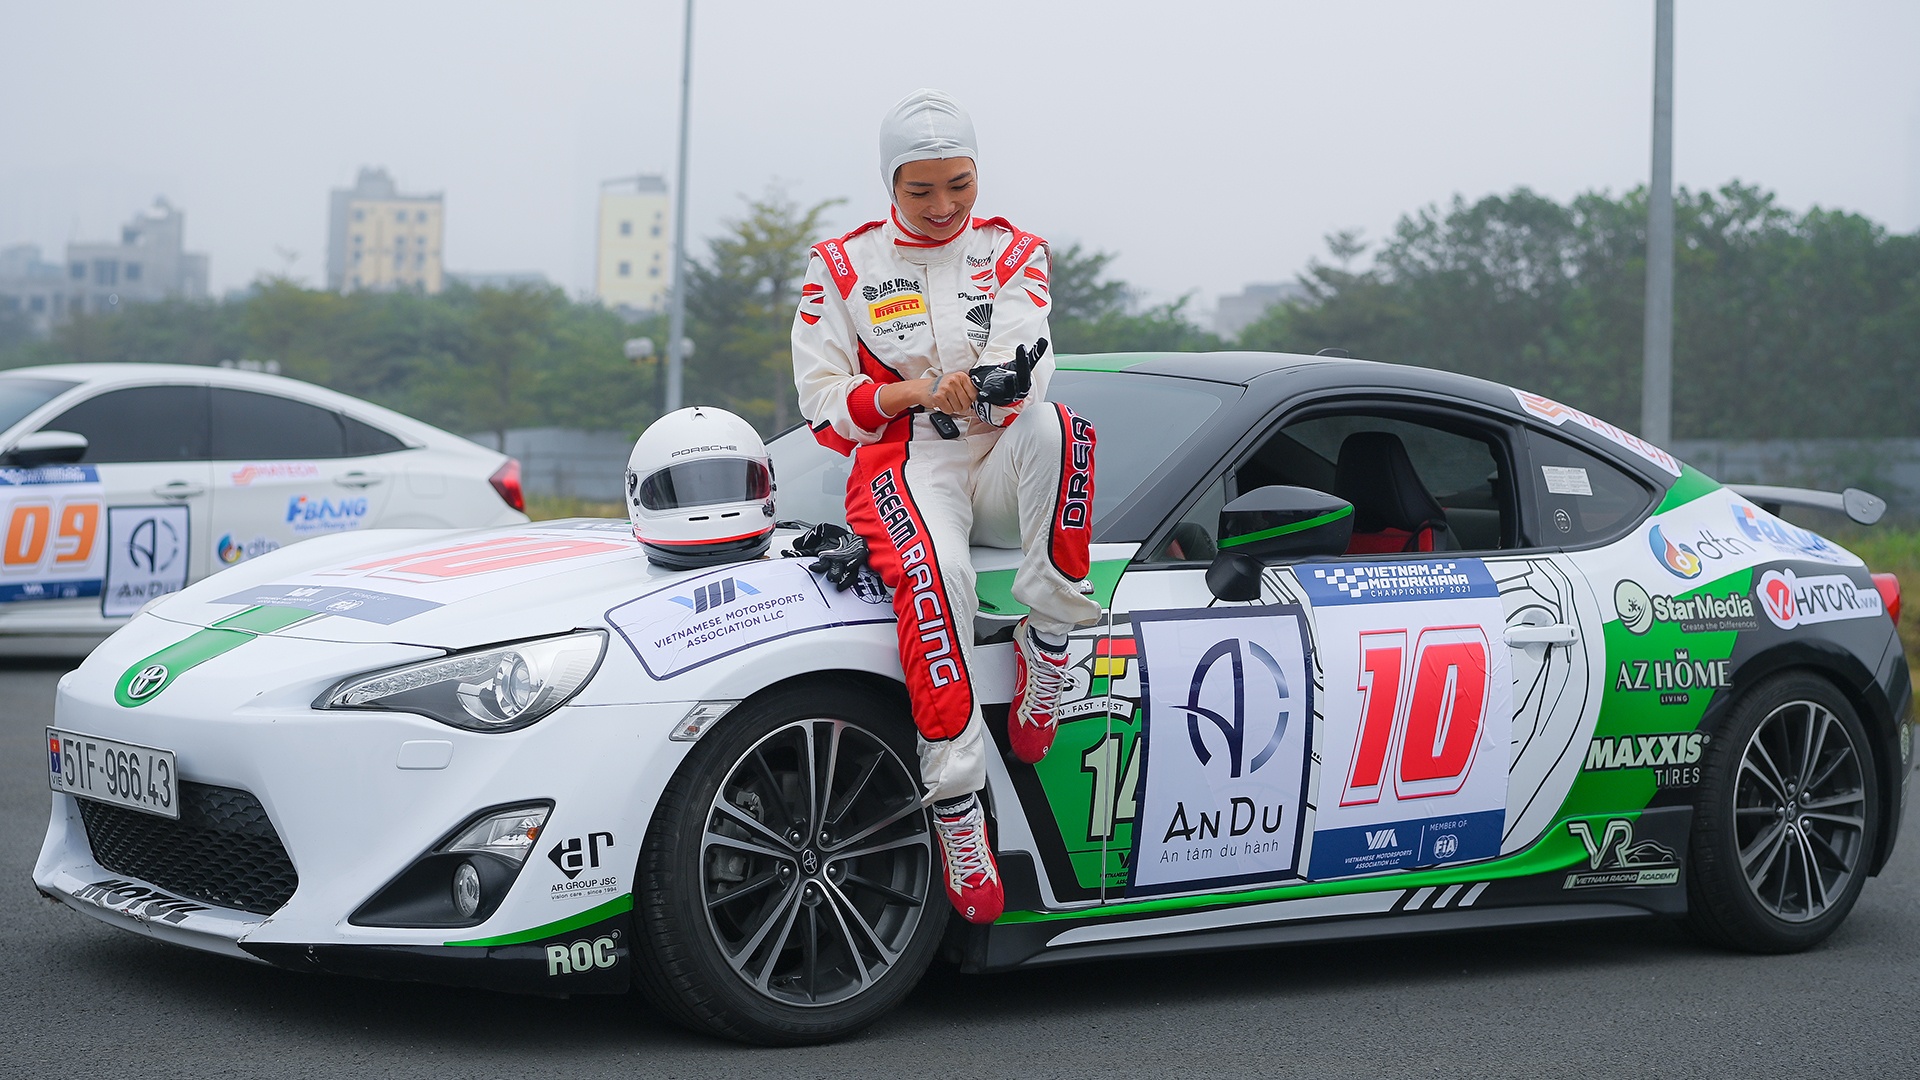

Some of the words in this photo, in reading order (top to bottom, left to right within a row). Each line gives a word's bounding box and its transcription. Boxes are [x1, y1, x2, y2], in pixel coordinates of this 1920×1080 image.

[827, 242, 849, 276] sparco
[1004, 236, 1030, 267] sparco
[878, 280, 893, 295] LAS
[894, 278, 920, 291] VEGAS
[873, 298, 920, 319] PIRELLI
[872, 325, 894, 337] Dom
[671, 444, 738, 458] PORSCHE
[1062, 404, 1093, 530] DREA
[870, 467, 918, 550] DREAM
[2, 501, 100, 569] 09
[1696, 530, 1757, 560] dtn
[1364, 564, 1429, 578] VIETNAM
[1368, 574, 1470, 590] MOTORKHANA
[1370, 587, 1445, 598] CHAMPIONSHIP
[1449, 585, 1471, 593] 2021
[900, 540, 961, 690] RACING
[1653, 593, 1755, 621] StarMedia
[654, 616, 722, 649] VIETNAMESE
[725, 593, 805, 622] MOTORSPORTS
[686, 617, 761, 648] ASSOCIATION
[764, 610, 785, 623] LLC
[1681, 622, 1704, 632] Create
[1706, 621, 1718, 630] the
[1719, 620, 1757, 630] Differences
[1615, 661, 1650, 690] AZ
[1654, 660, 1733, 689] HOME
[1072, 701, 1094, 714] FAST
[1661, 695, 1689, 704] LIVING
[1343, 631, 1491, 800] 10
[51, 772, 63, 787] VIE
[63, 738, 171, 808] 51F-966.43
[1655, 767, 1700, 787] TIRES
[1429, 821, 1456, 832] MEMBER
[1458, 820, 1468, 828] OF
[1160, 850, 1179, 864] An
[1186, 847, 1213, 861] tâm
[1220, 844, 1238, 858] du
[1244, 839, 1279, 855] hành
[1345, 854, 1375, 864] VIETNAMESE
[1376, 850, 1413, 860] MOTORSPORTS
[1355, 861, 1388, 869] ASSOCIATION
[551, 883, 564, 892] AR
[565, 879, 598, 890] GROUP
[599, 876, 617, 886] JSC
[1576, 875, 1609, 885] VIETNAM
[1609, 873, 1638, 882] RACING
[1640, 871, 1676, 881] ACADEMY
